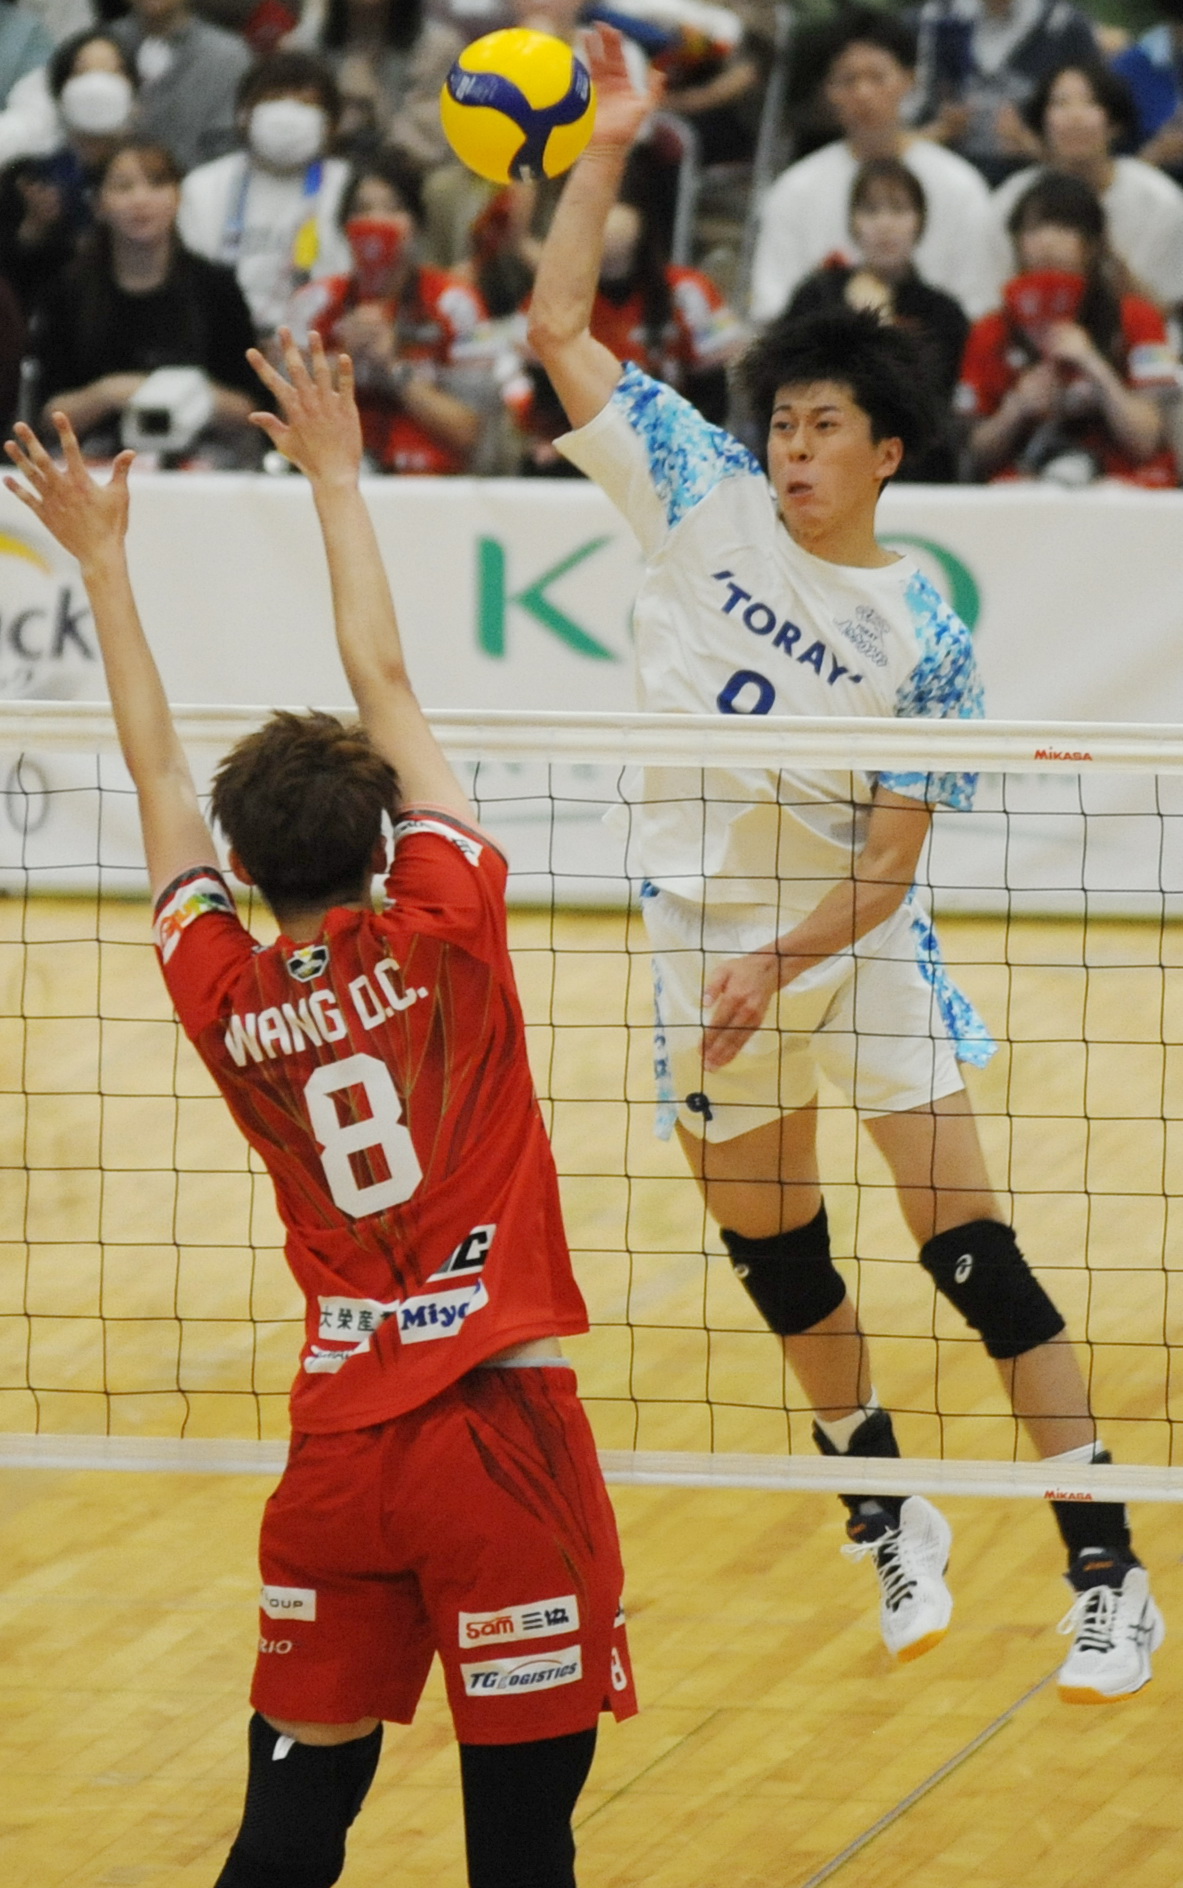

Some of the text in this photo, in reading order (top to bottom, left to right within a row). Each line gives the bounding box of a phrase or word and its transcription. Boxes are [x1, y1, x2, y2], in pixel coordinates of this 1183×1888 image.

[0, 585, 94, 662] ck
[224, 957, 429, 1067] WANG D.C.
[303, 1052, 424, 1219] 8
